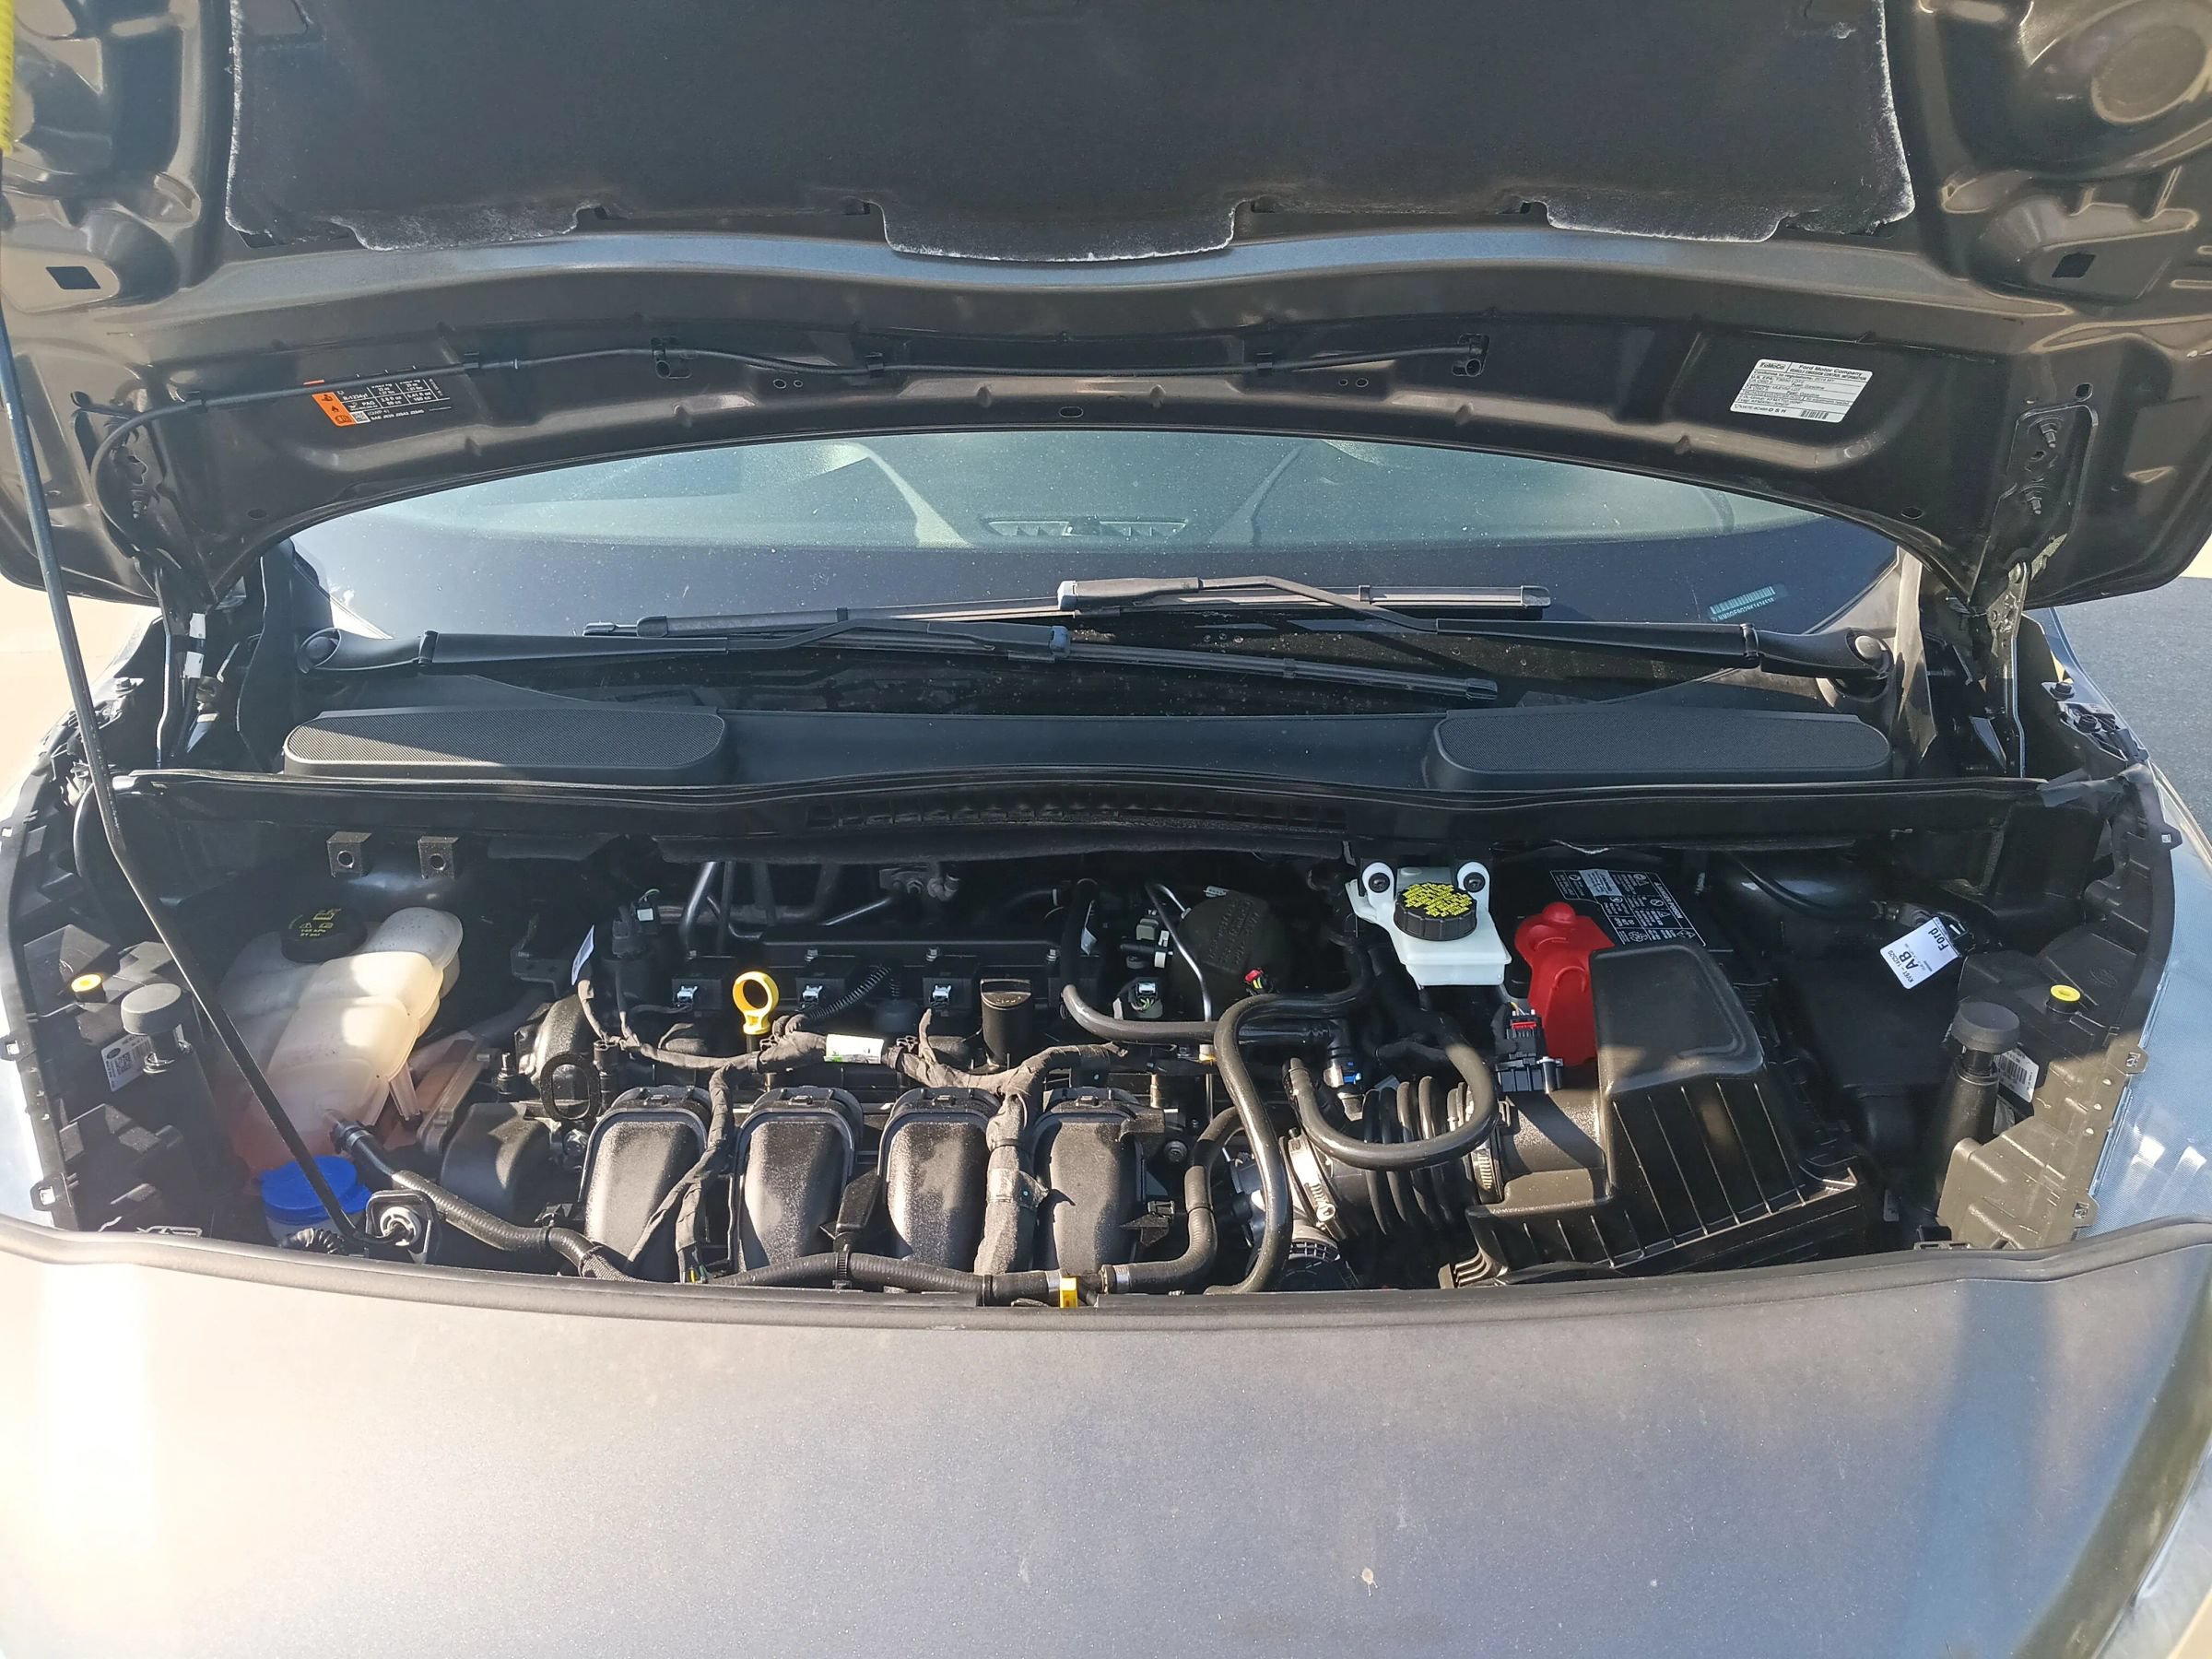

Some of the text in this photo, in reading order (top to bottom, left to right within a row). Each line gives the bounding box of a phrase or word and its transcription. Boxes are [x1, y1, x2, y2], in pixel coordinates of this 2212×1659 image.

[1668, 902, 1683, 918] POISON
[1928, 928, 1949, 951] Ford
[1899, 951, 1919, 970] AB
